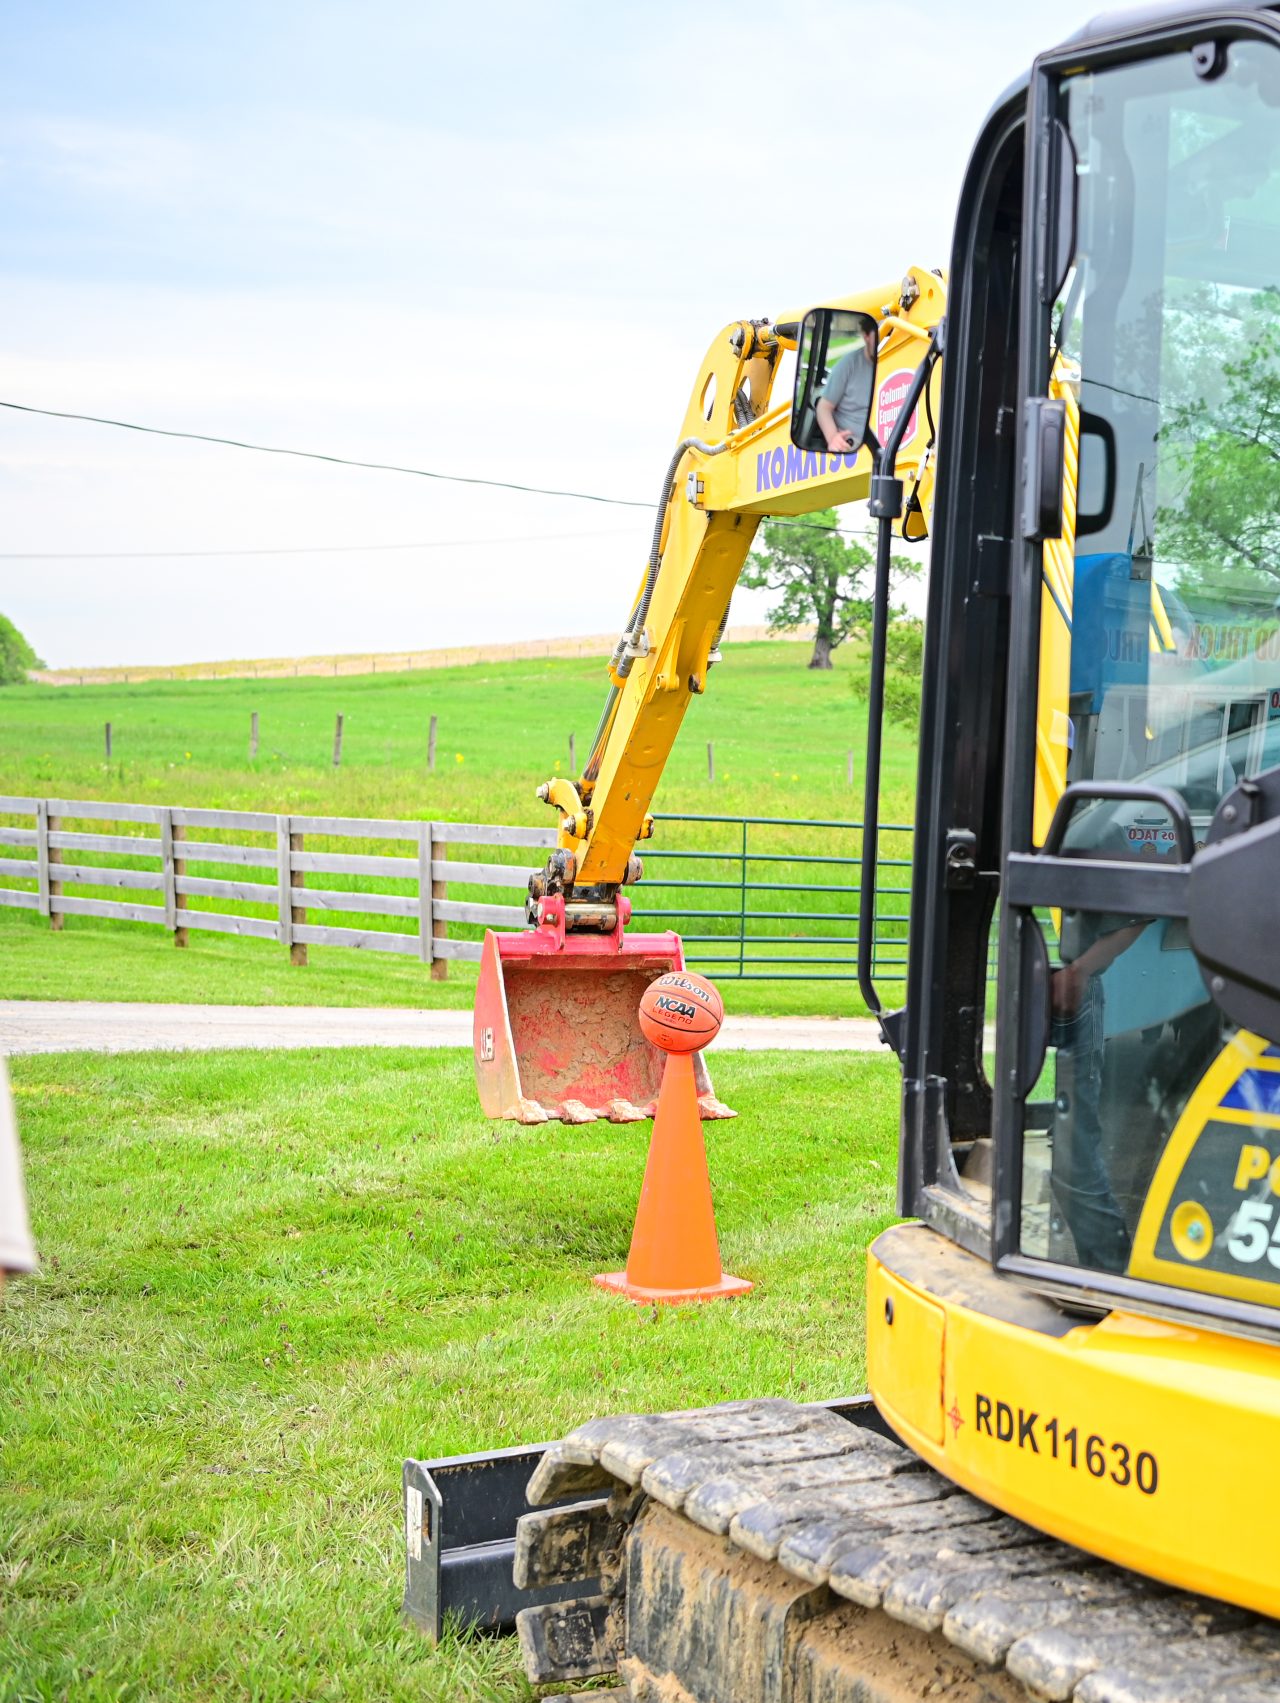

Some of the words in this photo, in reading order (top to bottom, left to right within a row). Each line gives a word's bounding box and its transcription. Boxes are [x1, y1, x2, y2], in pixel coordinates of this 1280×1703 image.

[880, 383, 911, 407] Columb
[879, 405, 903, 425] Equip
[659, 976, 711, 1003] Wilson
[652, 1007, 693, 1025] LEGEND
[655, 995, 697, 1019] NCAA
[974, 1393, 1160, 1496] RDK11630
